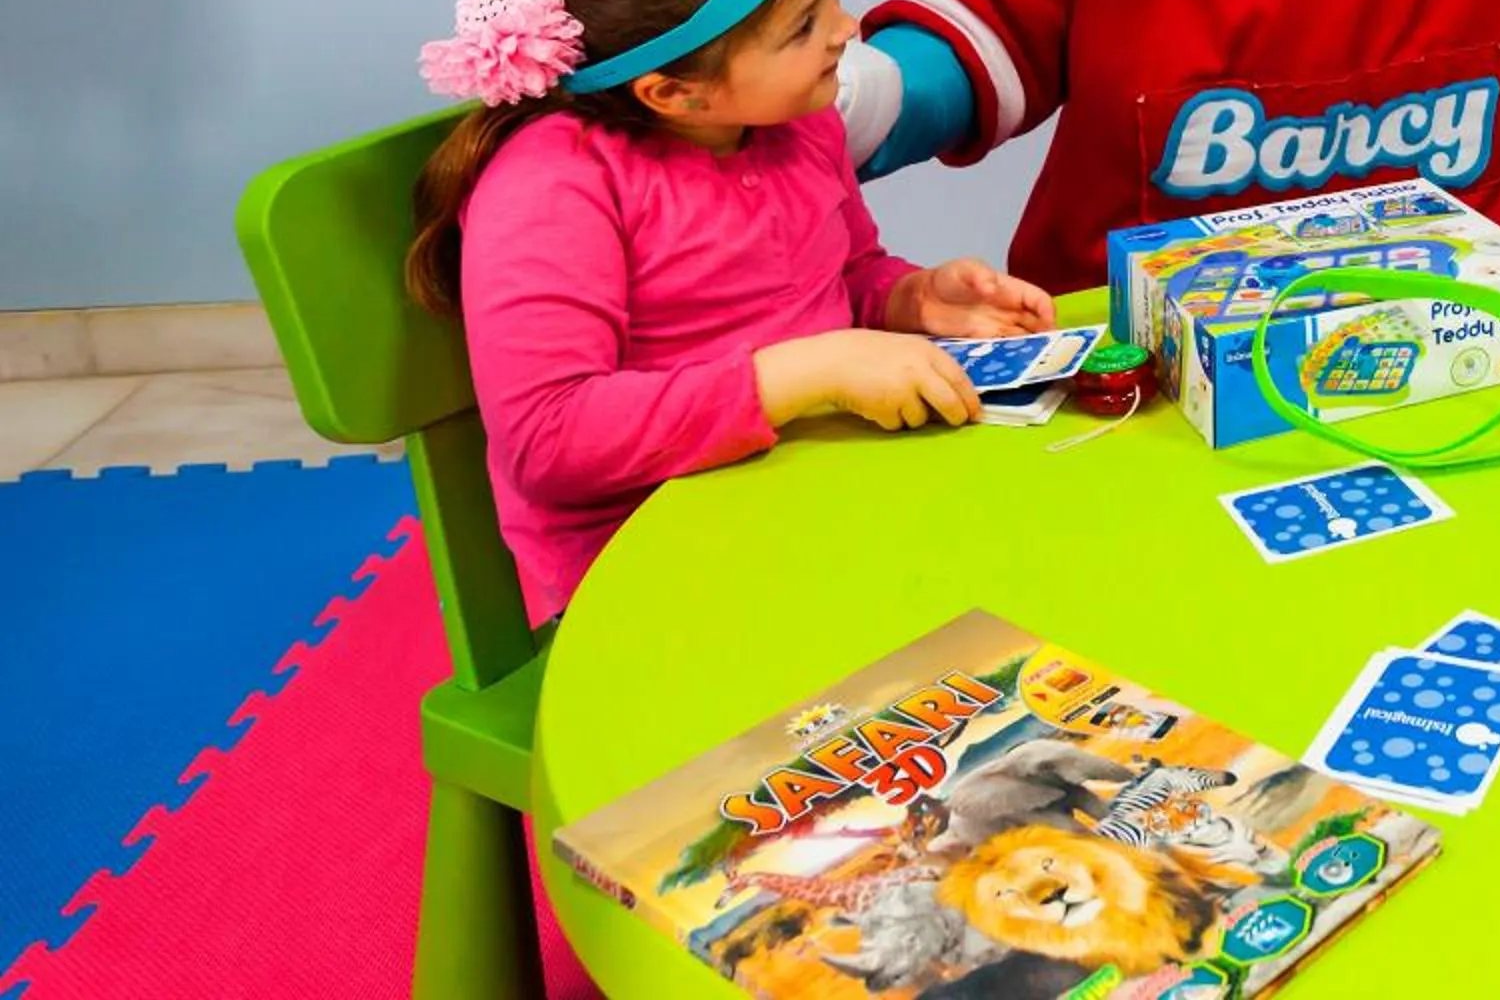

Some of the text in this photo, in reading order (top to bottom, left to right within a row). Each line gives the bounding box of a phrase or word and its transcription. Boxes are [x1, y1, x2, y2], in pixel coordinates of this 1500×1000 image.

[1164, 87, 1491, 189] Barcy
[1210, 184, 1417, 226] Prof. Teddy Sabio
[1432, 319, 1494, 345] Teddy
[719, 669, 1005, 836] SAFARI
[860, 742, 951, 806] 3D
